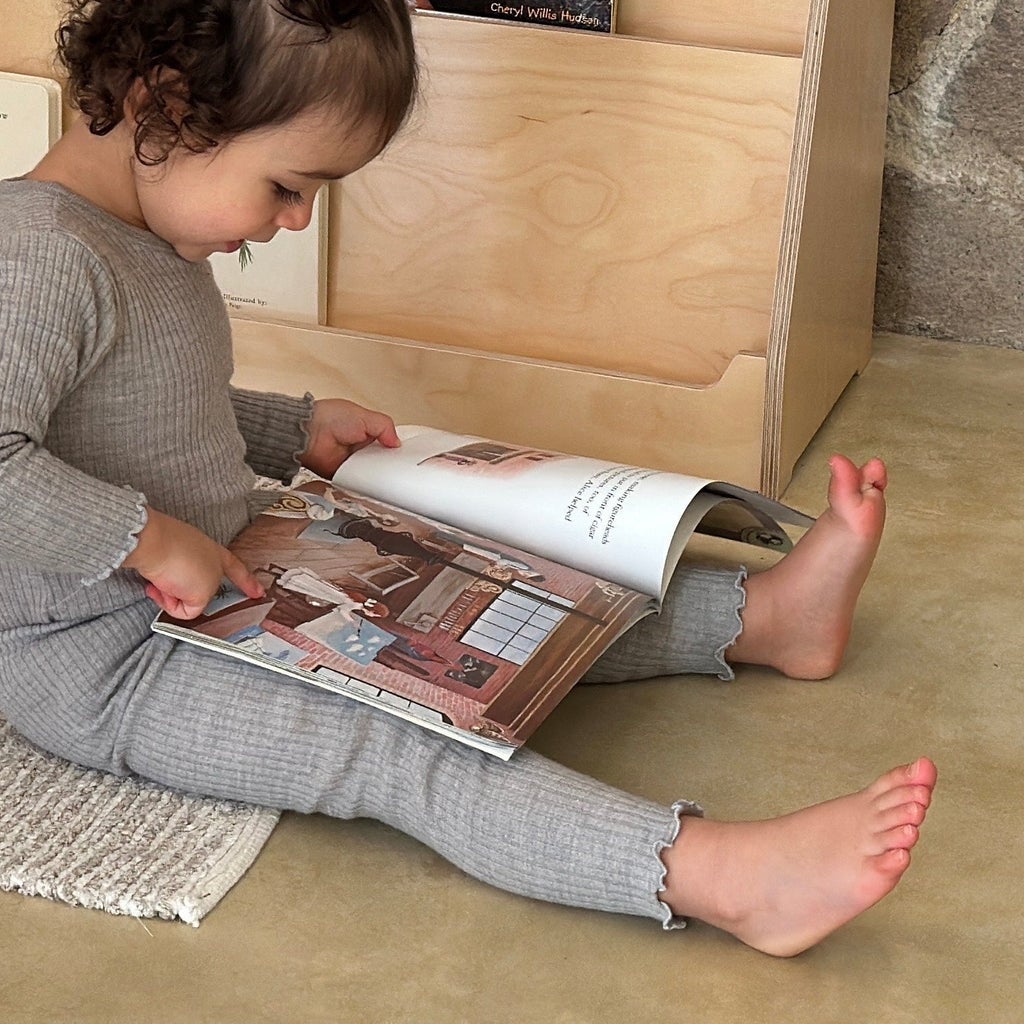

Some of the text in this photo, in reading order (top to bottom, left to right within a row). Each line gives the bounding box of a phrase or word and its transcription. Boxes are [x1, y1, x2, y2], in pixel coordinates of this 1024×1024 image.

[490, 2, 600, 27] Cheryl Willis Hudson
[564, 479, 594, 522] Alice helped
[582, 505, 590, 517] of
[599, 492, 614, 510] front
[595, 510, 603, 522] of
[601, 503, 624, 545] figureheads
